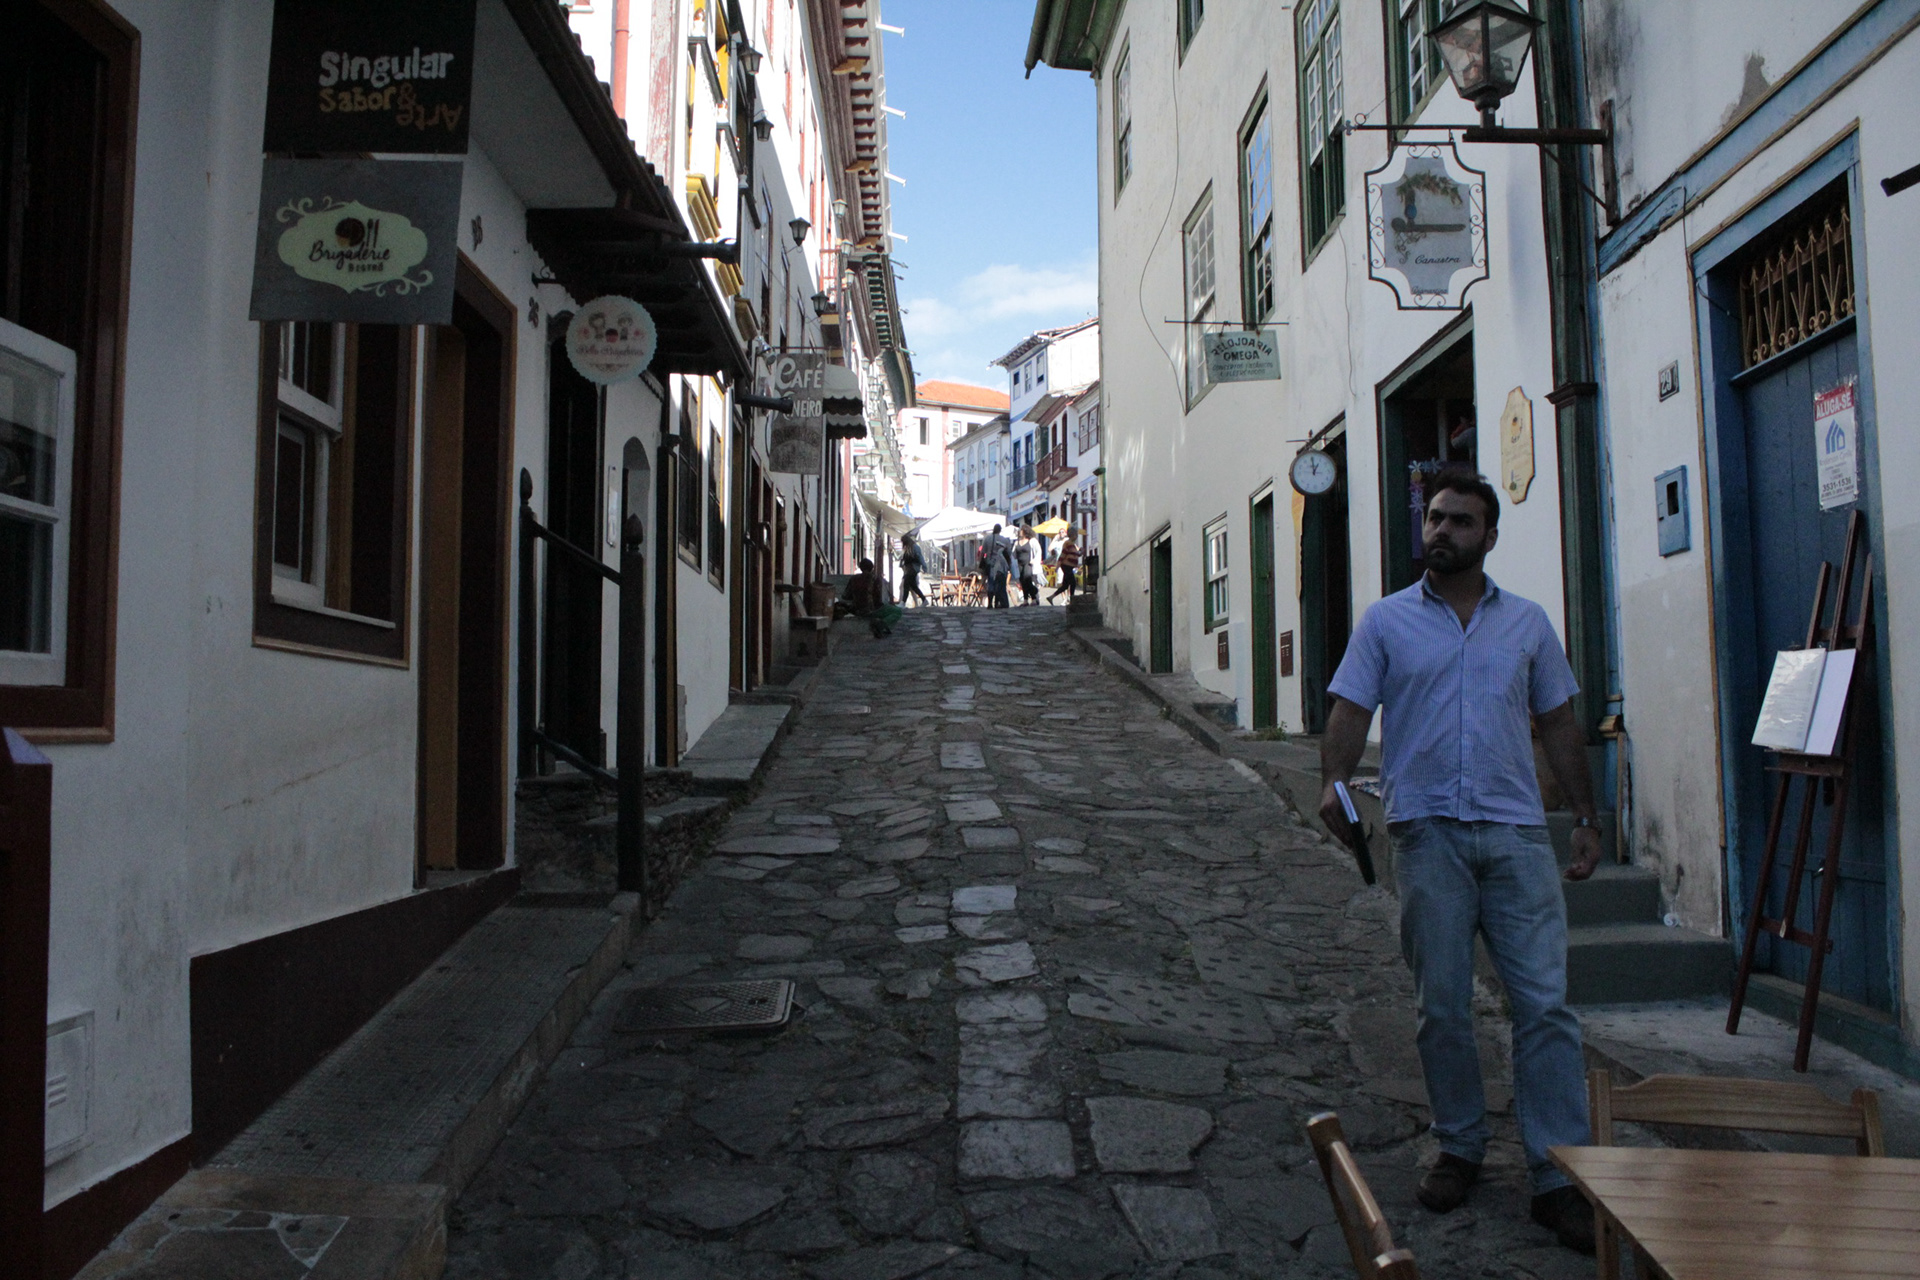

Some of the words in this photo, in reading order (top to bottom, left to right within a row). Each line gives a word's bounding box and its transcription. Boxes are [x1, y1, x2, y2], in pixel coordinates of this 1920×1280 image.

[318, 46, 455, 89] Singular
[319, 86, 398, 113] Sabor
[309, 240, 391, 270] Brigaderie
[1415, 254, 1462, 265] Canastra
[1211, 337, 1273, 356] RELOJOARIA
[1223, 350, 1261, 361] OMEGA
[776, 358, 823, 389] CAFÉ
[1816, 392, 1852, 419] ALUGA-SE
